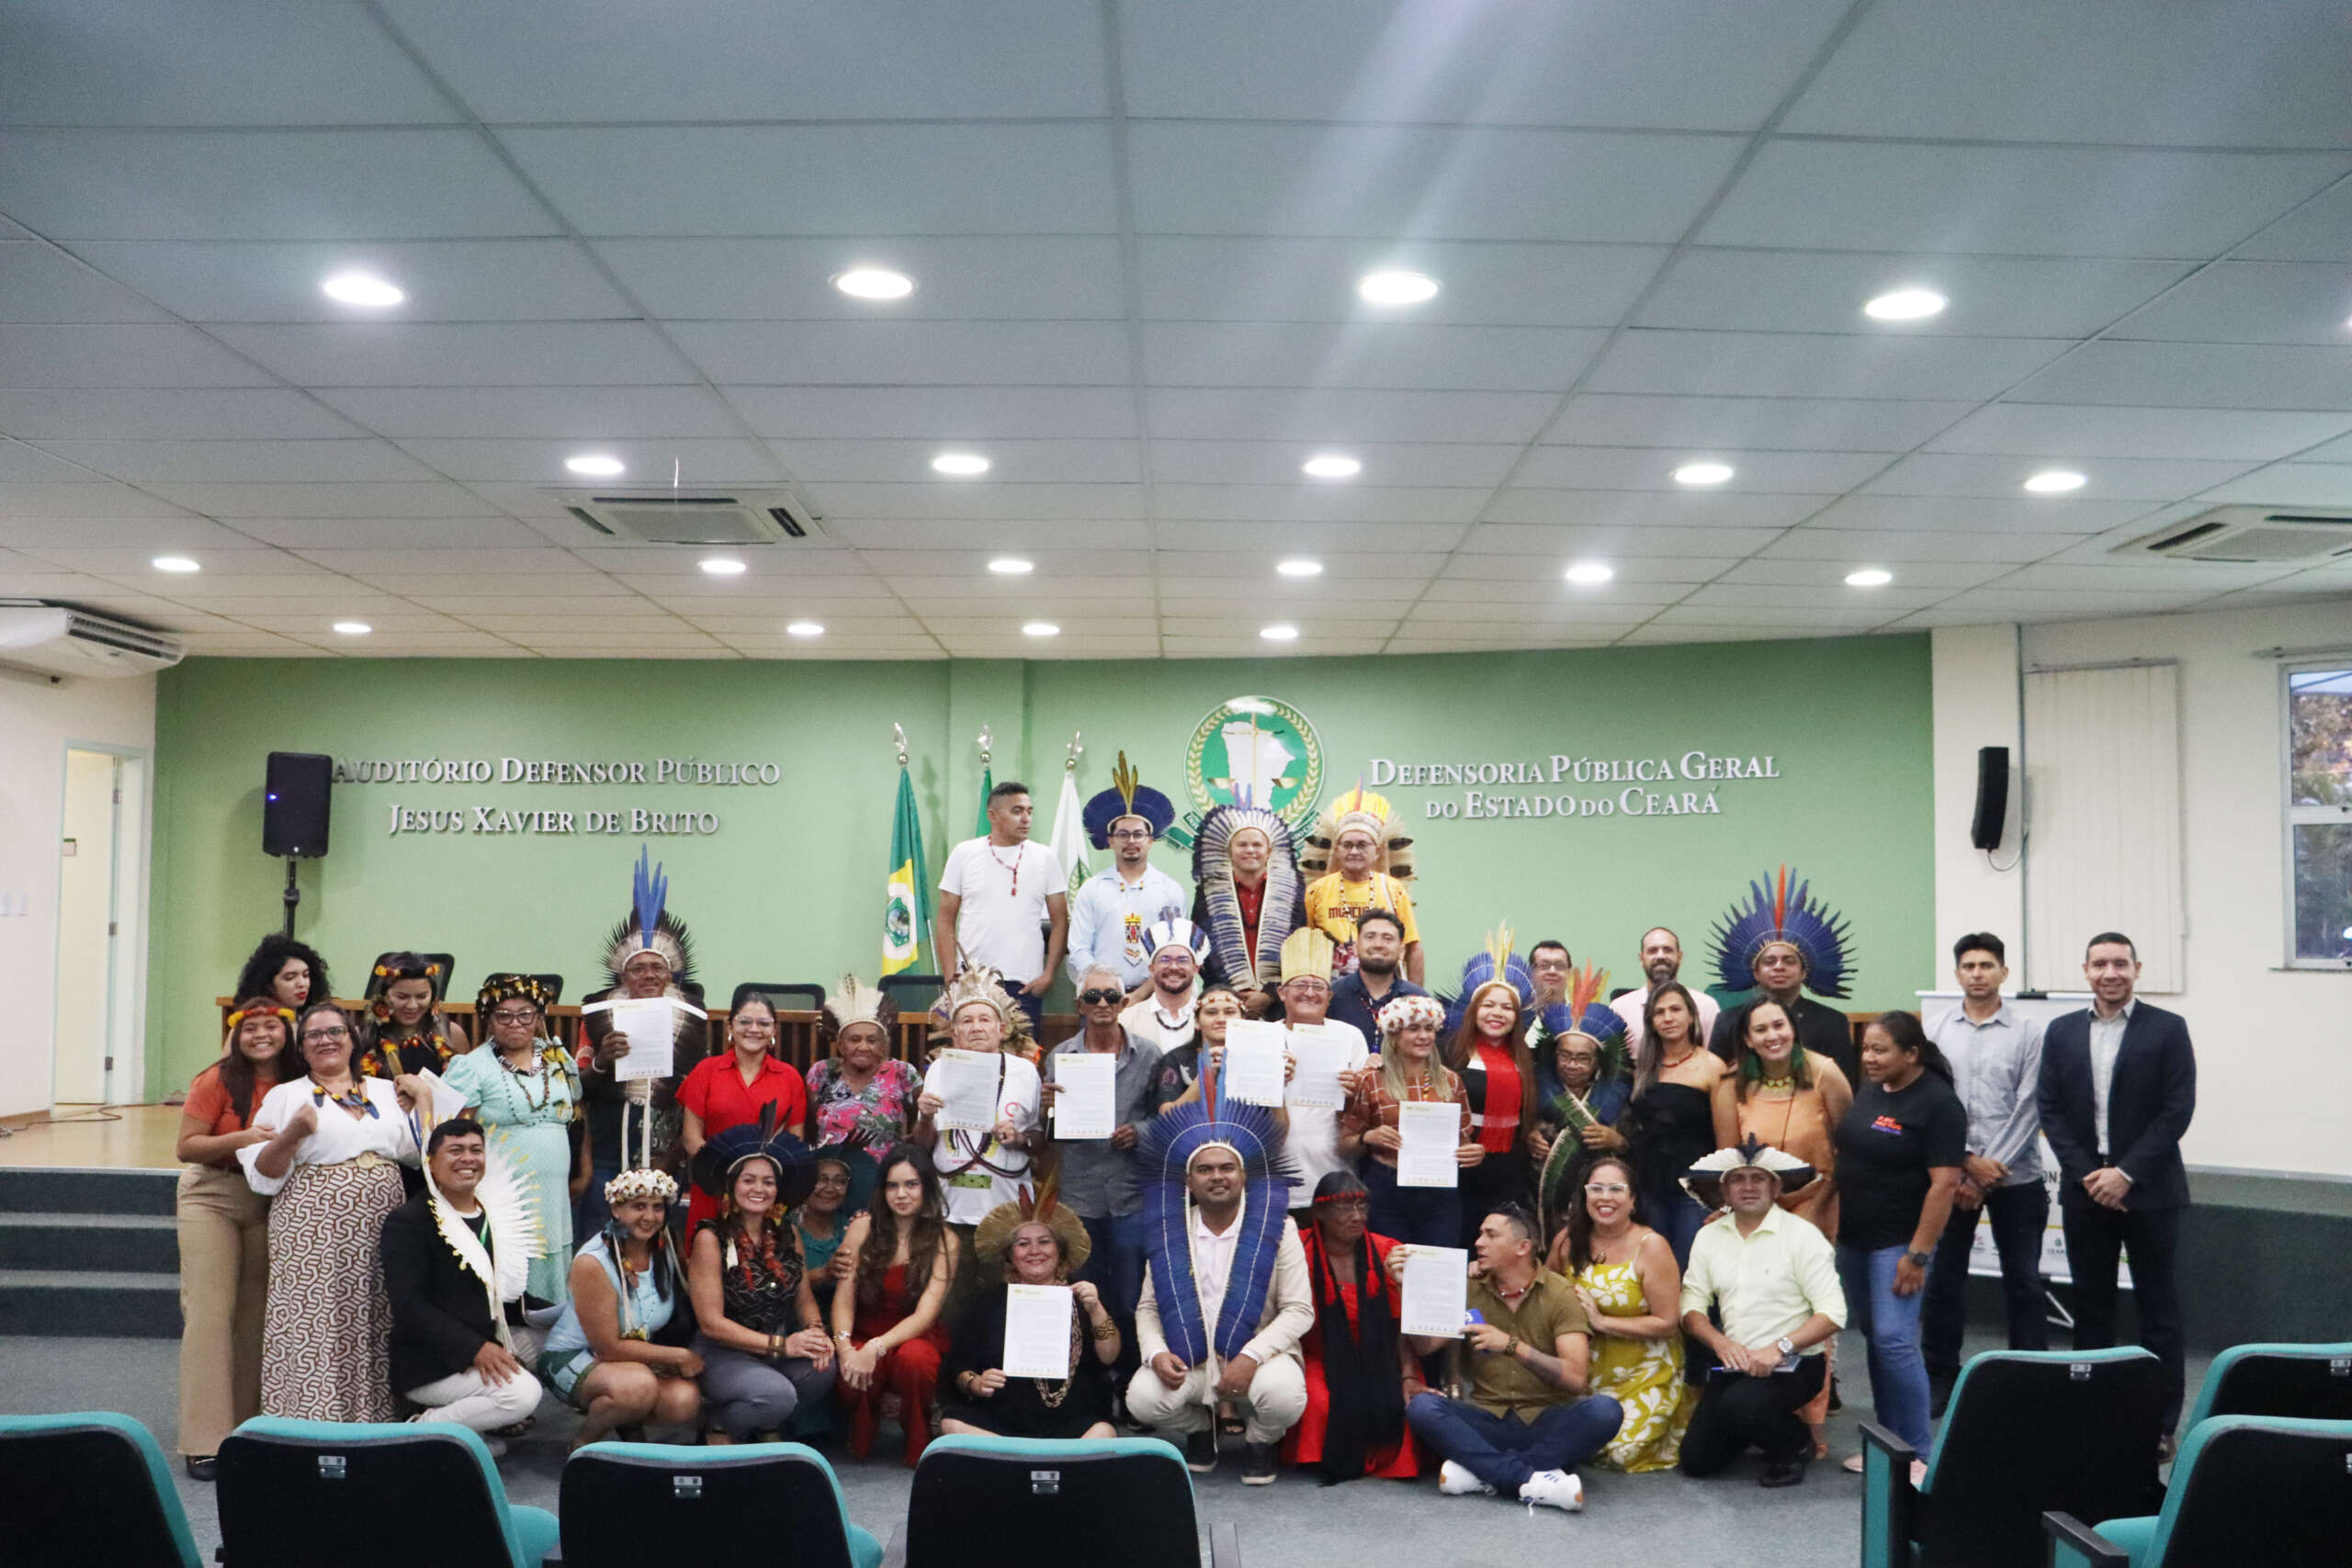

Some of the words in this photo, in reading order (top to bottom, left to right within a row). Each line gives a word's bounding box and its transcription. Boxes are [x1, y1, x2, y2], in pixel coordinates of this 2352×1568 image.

[500, 758, 647, 784] DEFENSOR
[657, 756, 780, 784] PÚBLICO
[1370, 759, 1545, 786] DEFENSORIA
[1549, 755, 1675, 783] PÚBLICA
[1679, 751, 1780, 780] GERAL
[1464, 791, 1577, 818] ESTADO
[1619, 785, 1720, 816] CEARÁ
[390, 805, 464, 834] JESUS
[471, 807, 575, 832] XAVIER
[629, 808, 718, 834] BRITO
